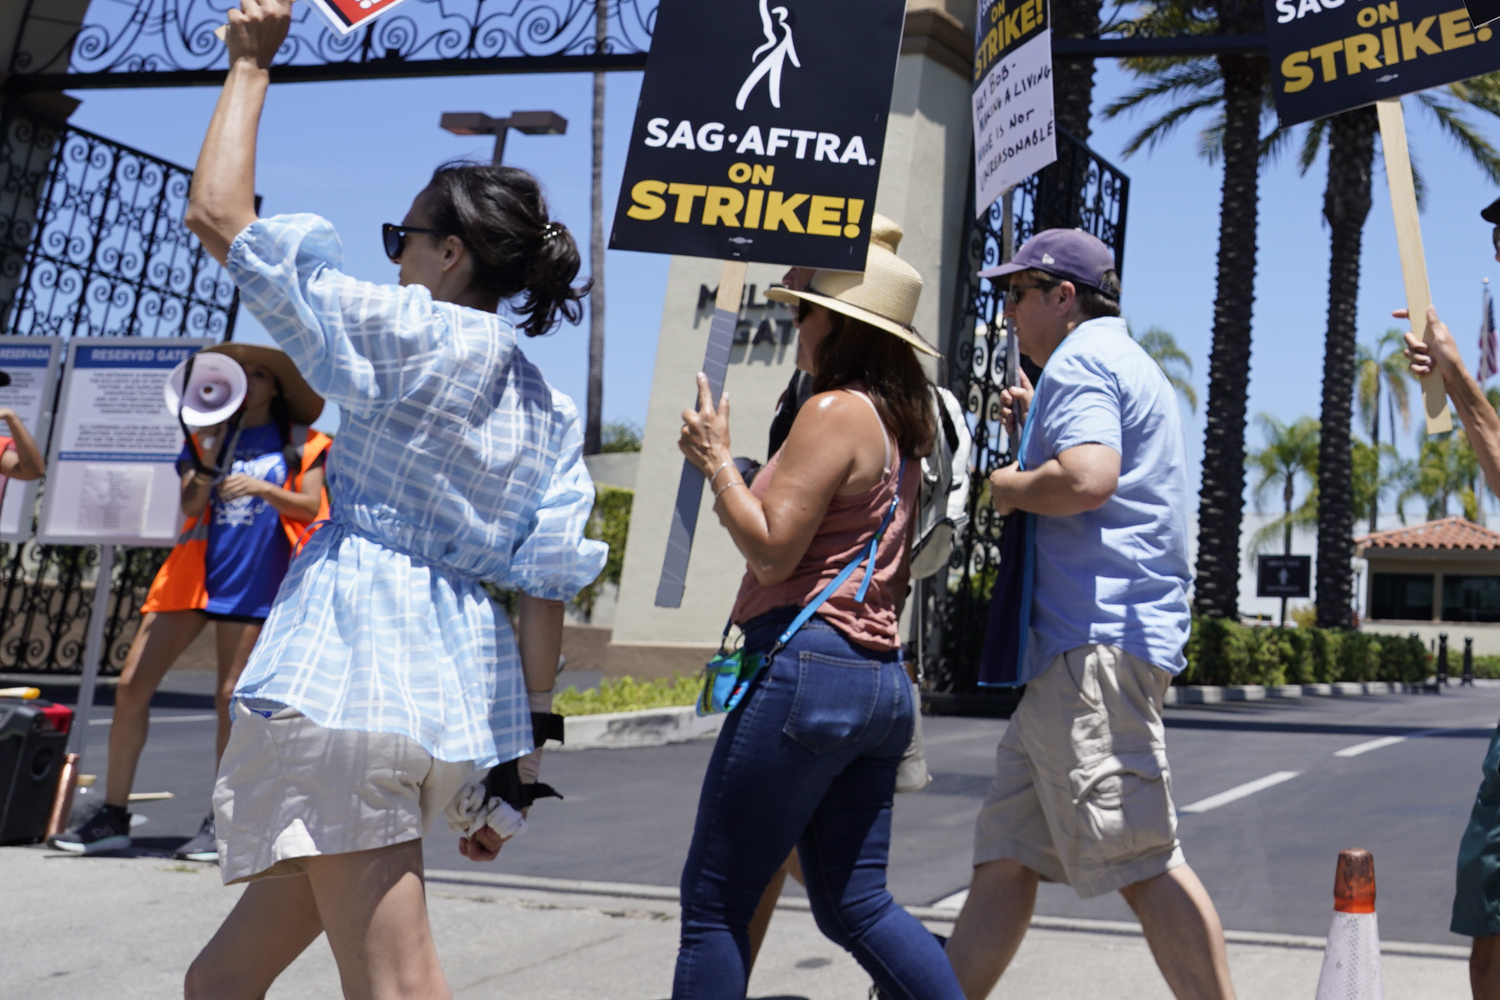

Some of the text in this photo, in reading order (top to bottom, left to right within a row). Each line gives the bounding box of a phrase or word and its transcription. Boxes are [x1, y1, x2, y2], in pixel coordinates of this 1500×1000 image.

[1357, 0, 1399, 28] ON
[1004, 87, 1012, 106] A
[728, 162, 775, 186] ON
[626, 179, 865, 239] STRIKE!
[91, 349, 155, 361] RESERVED
